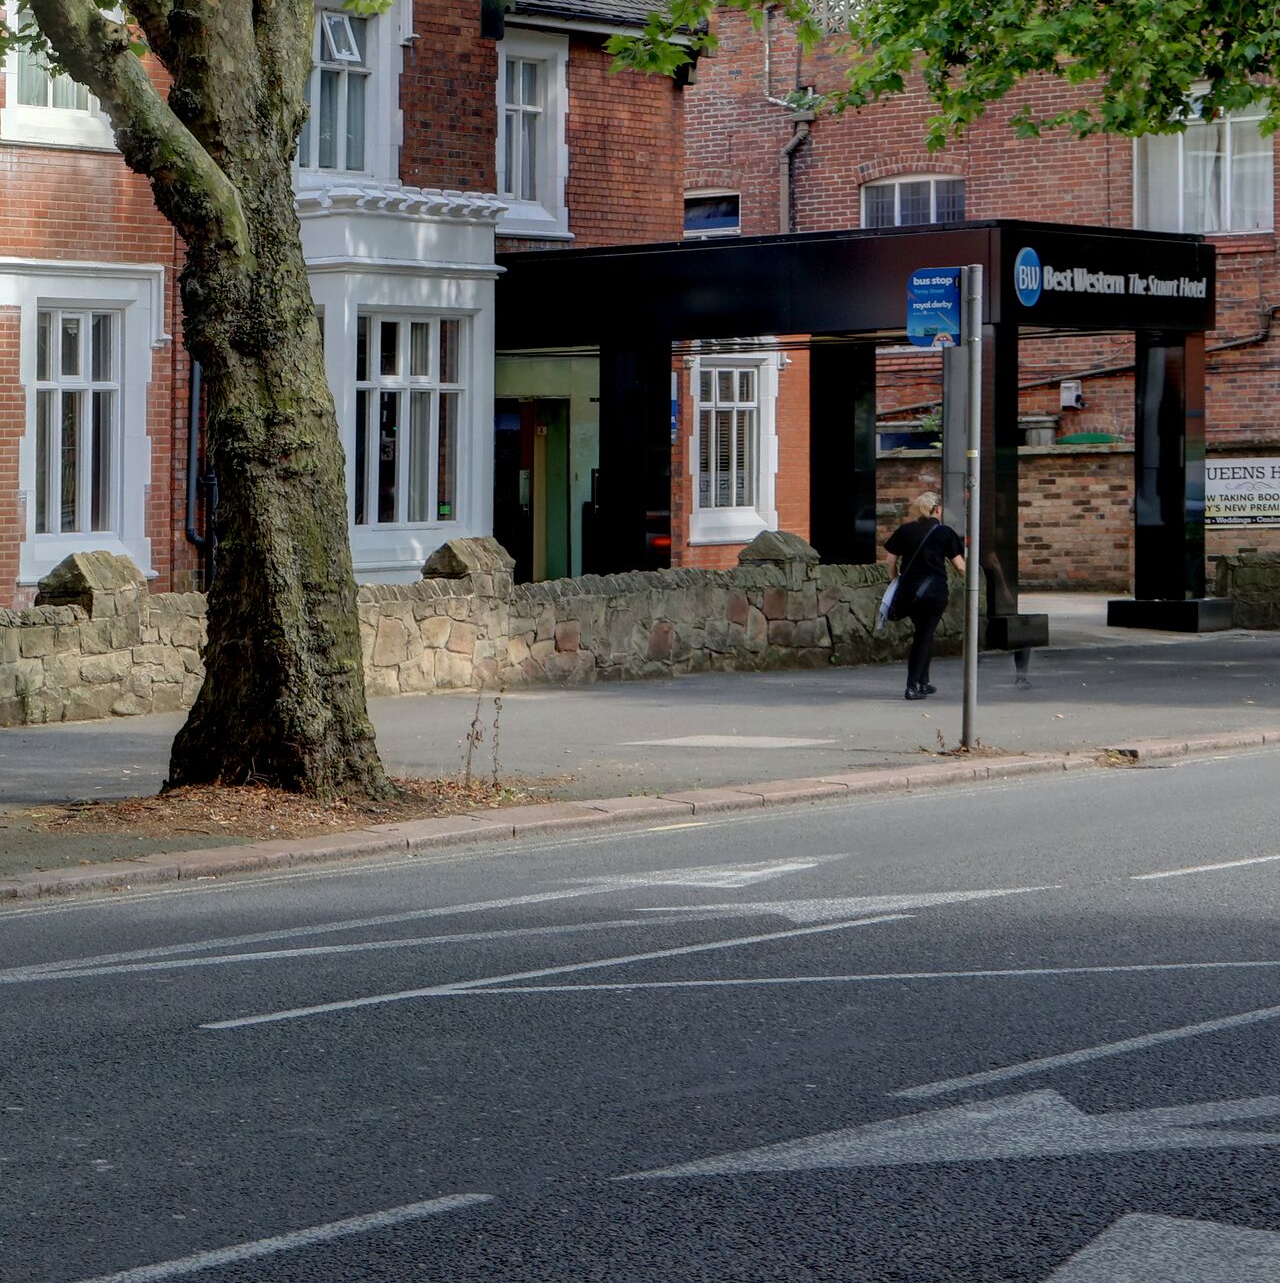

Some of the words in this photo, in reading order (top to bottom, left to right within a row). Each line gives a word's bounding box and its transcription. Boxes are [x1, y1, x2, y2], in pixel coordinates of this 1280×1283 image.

[912, 277, 931, 286] bus
[931, 277, 953, 286] stop
[1018, 265, 1040, 291] BW
[1043, 265, 1074, 292] Best
[1073, 267, 1126, 295] Western
[1128, 273, 1147, 295] The
[1147, 275, 1179, 297] Stuart
[1179, 276, 1207, 299] Hotel
[912, 300, 931, 310] royal
[931, 299, 953, 310] derby
[1206, 466, 1266, 481] UEENS
[1205, 494, 1216, 502] W
[1219, 493, 1255, 502] TAKING
[1205, 504, 1221, 512] Y'S
[1224, 504, 1247, 512] NEW
